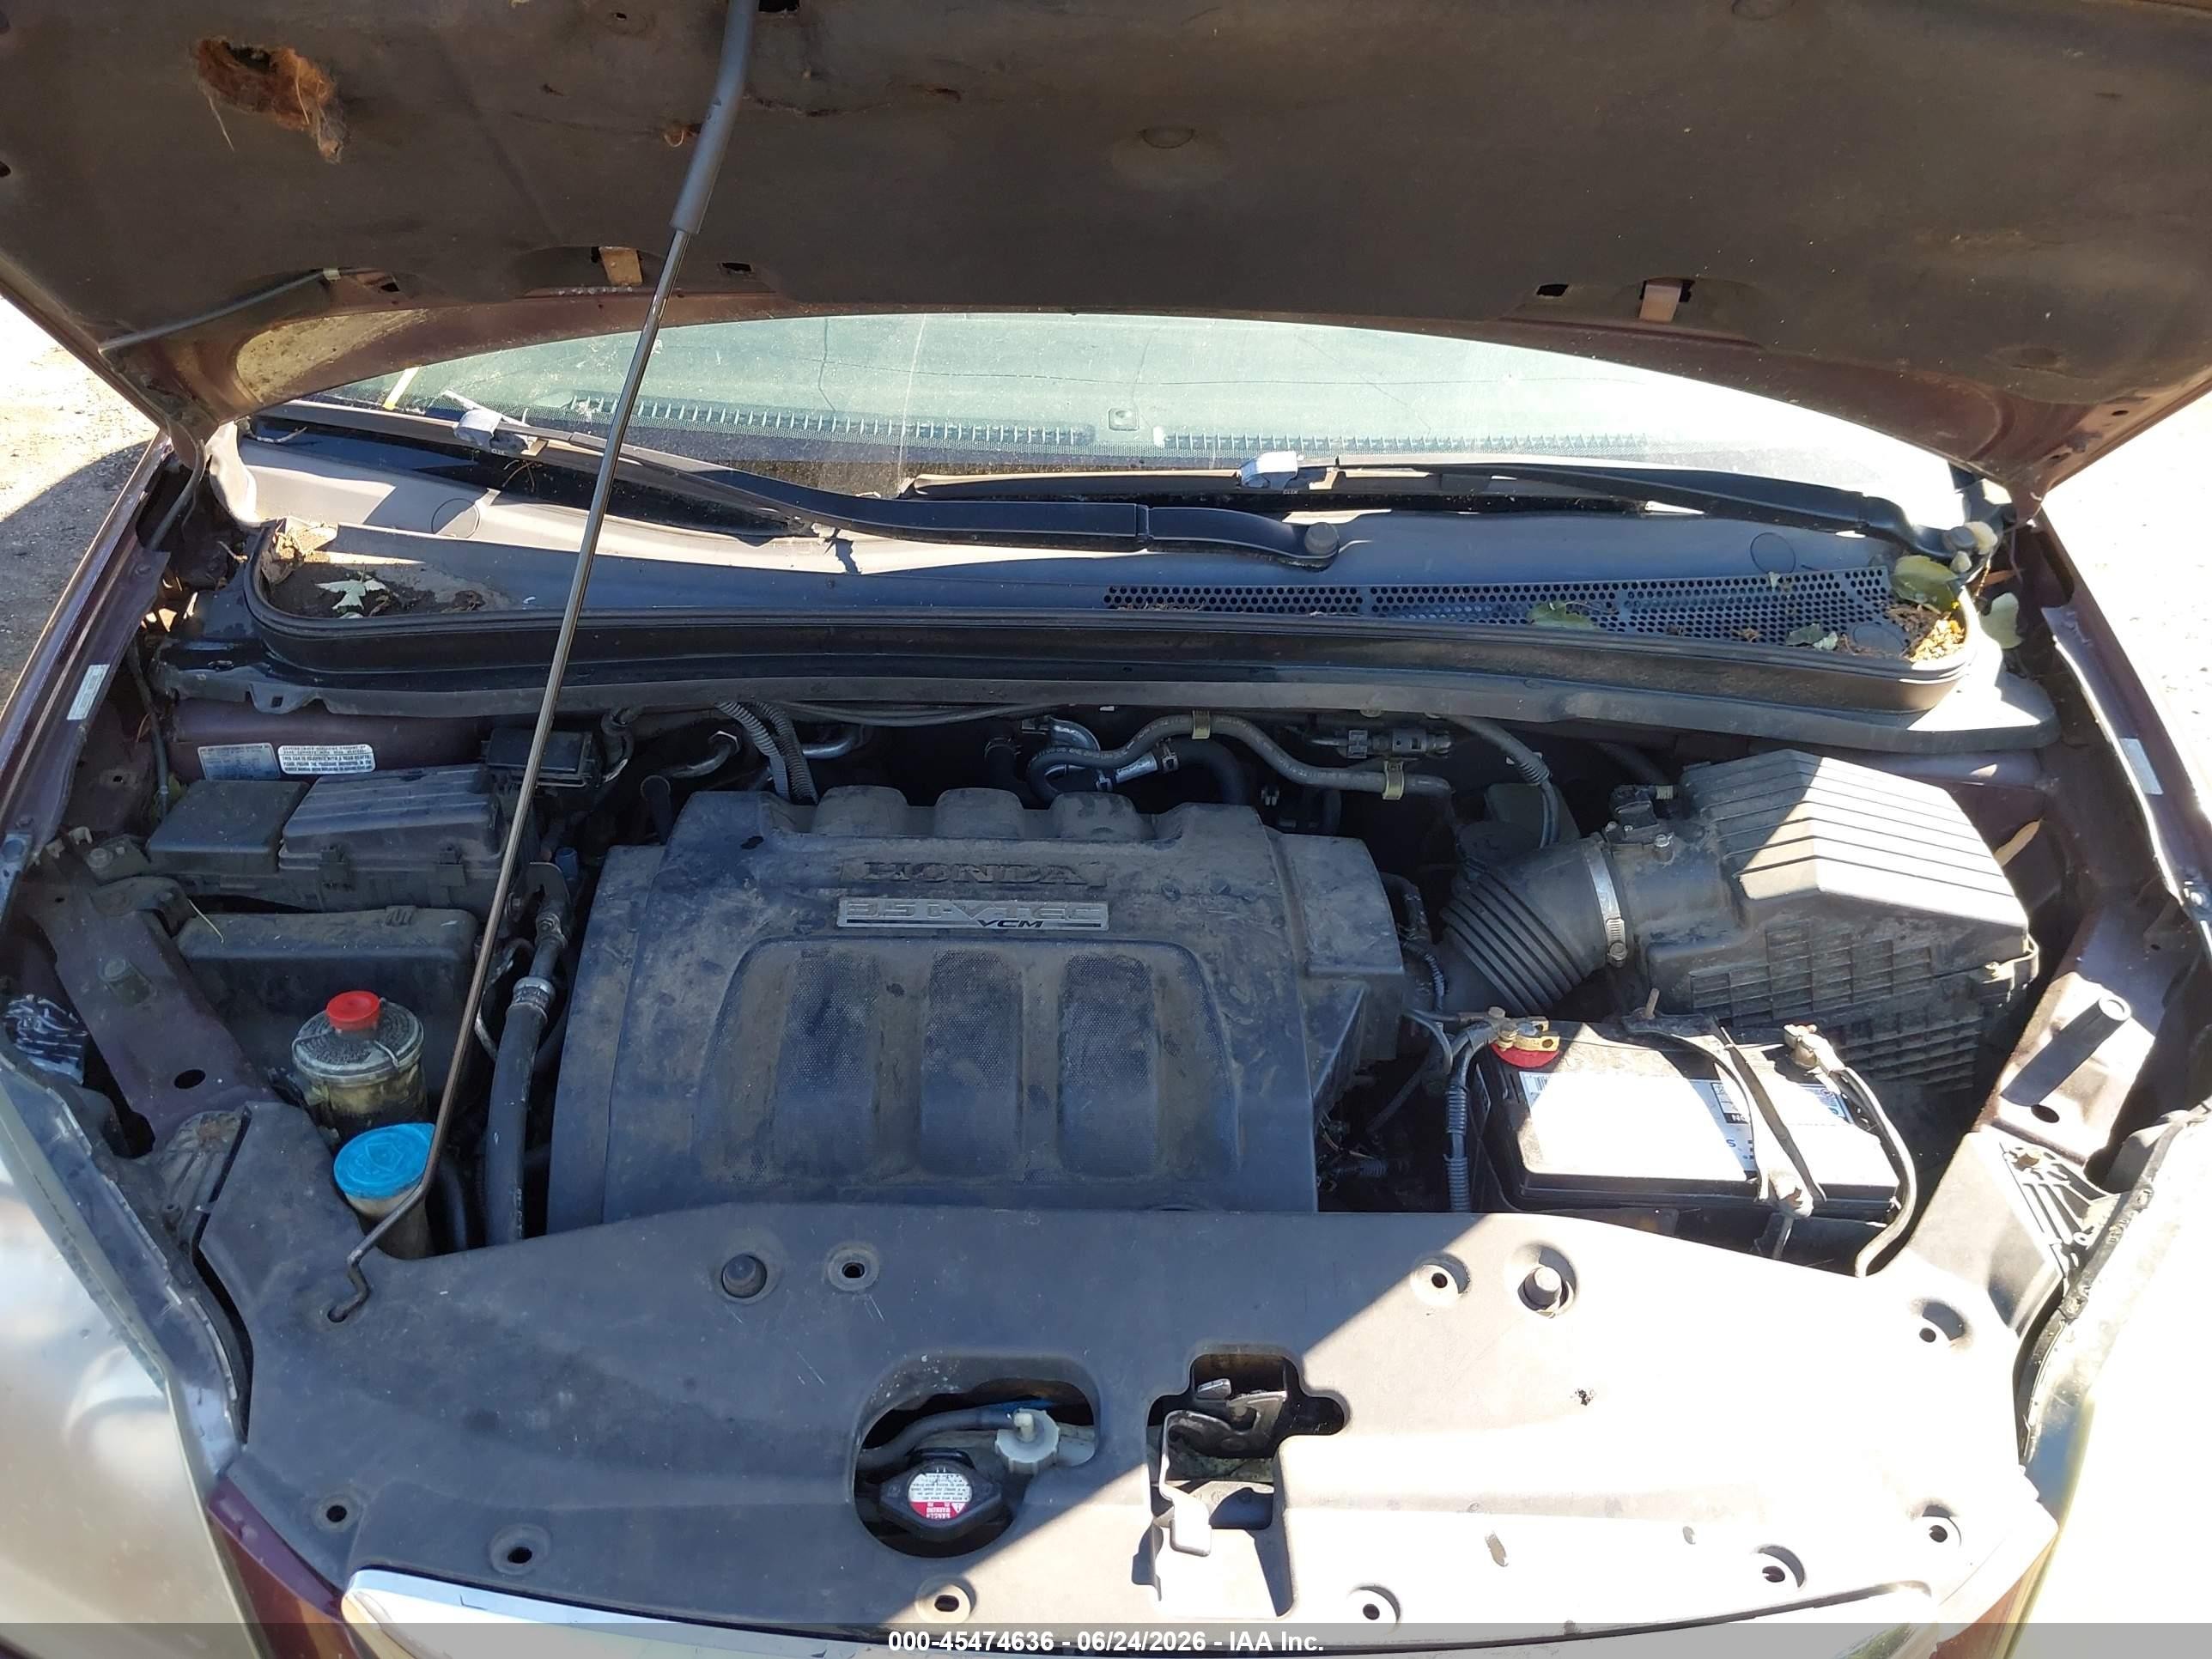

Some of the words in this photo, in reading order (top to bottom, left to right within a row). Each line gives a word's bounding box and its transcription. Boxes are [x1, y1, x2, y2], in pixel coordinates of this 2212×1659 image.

[863, 860, 1087, 885] HONDA
[847, 902, 916, 920] 3.5
[976, 920, 1045, 928] VCM
